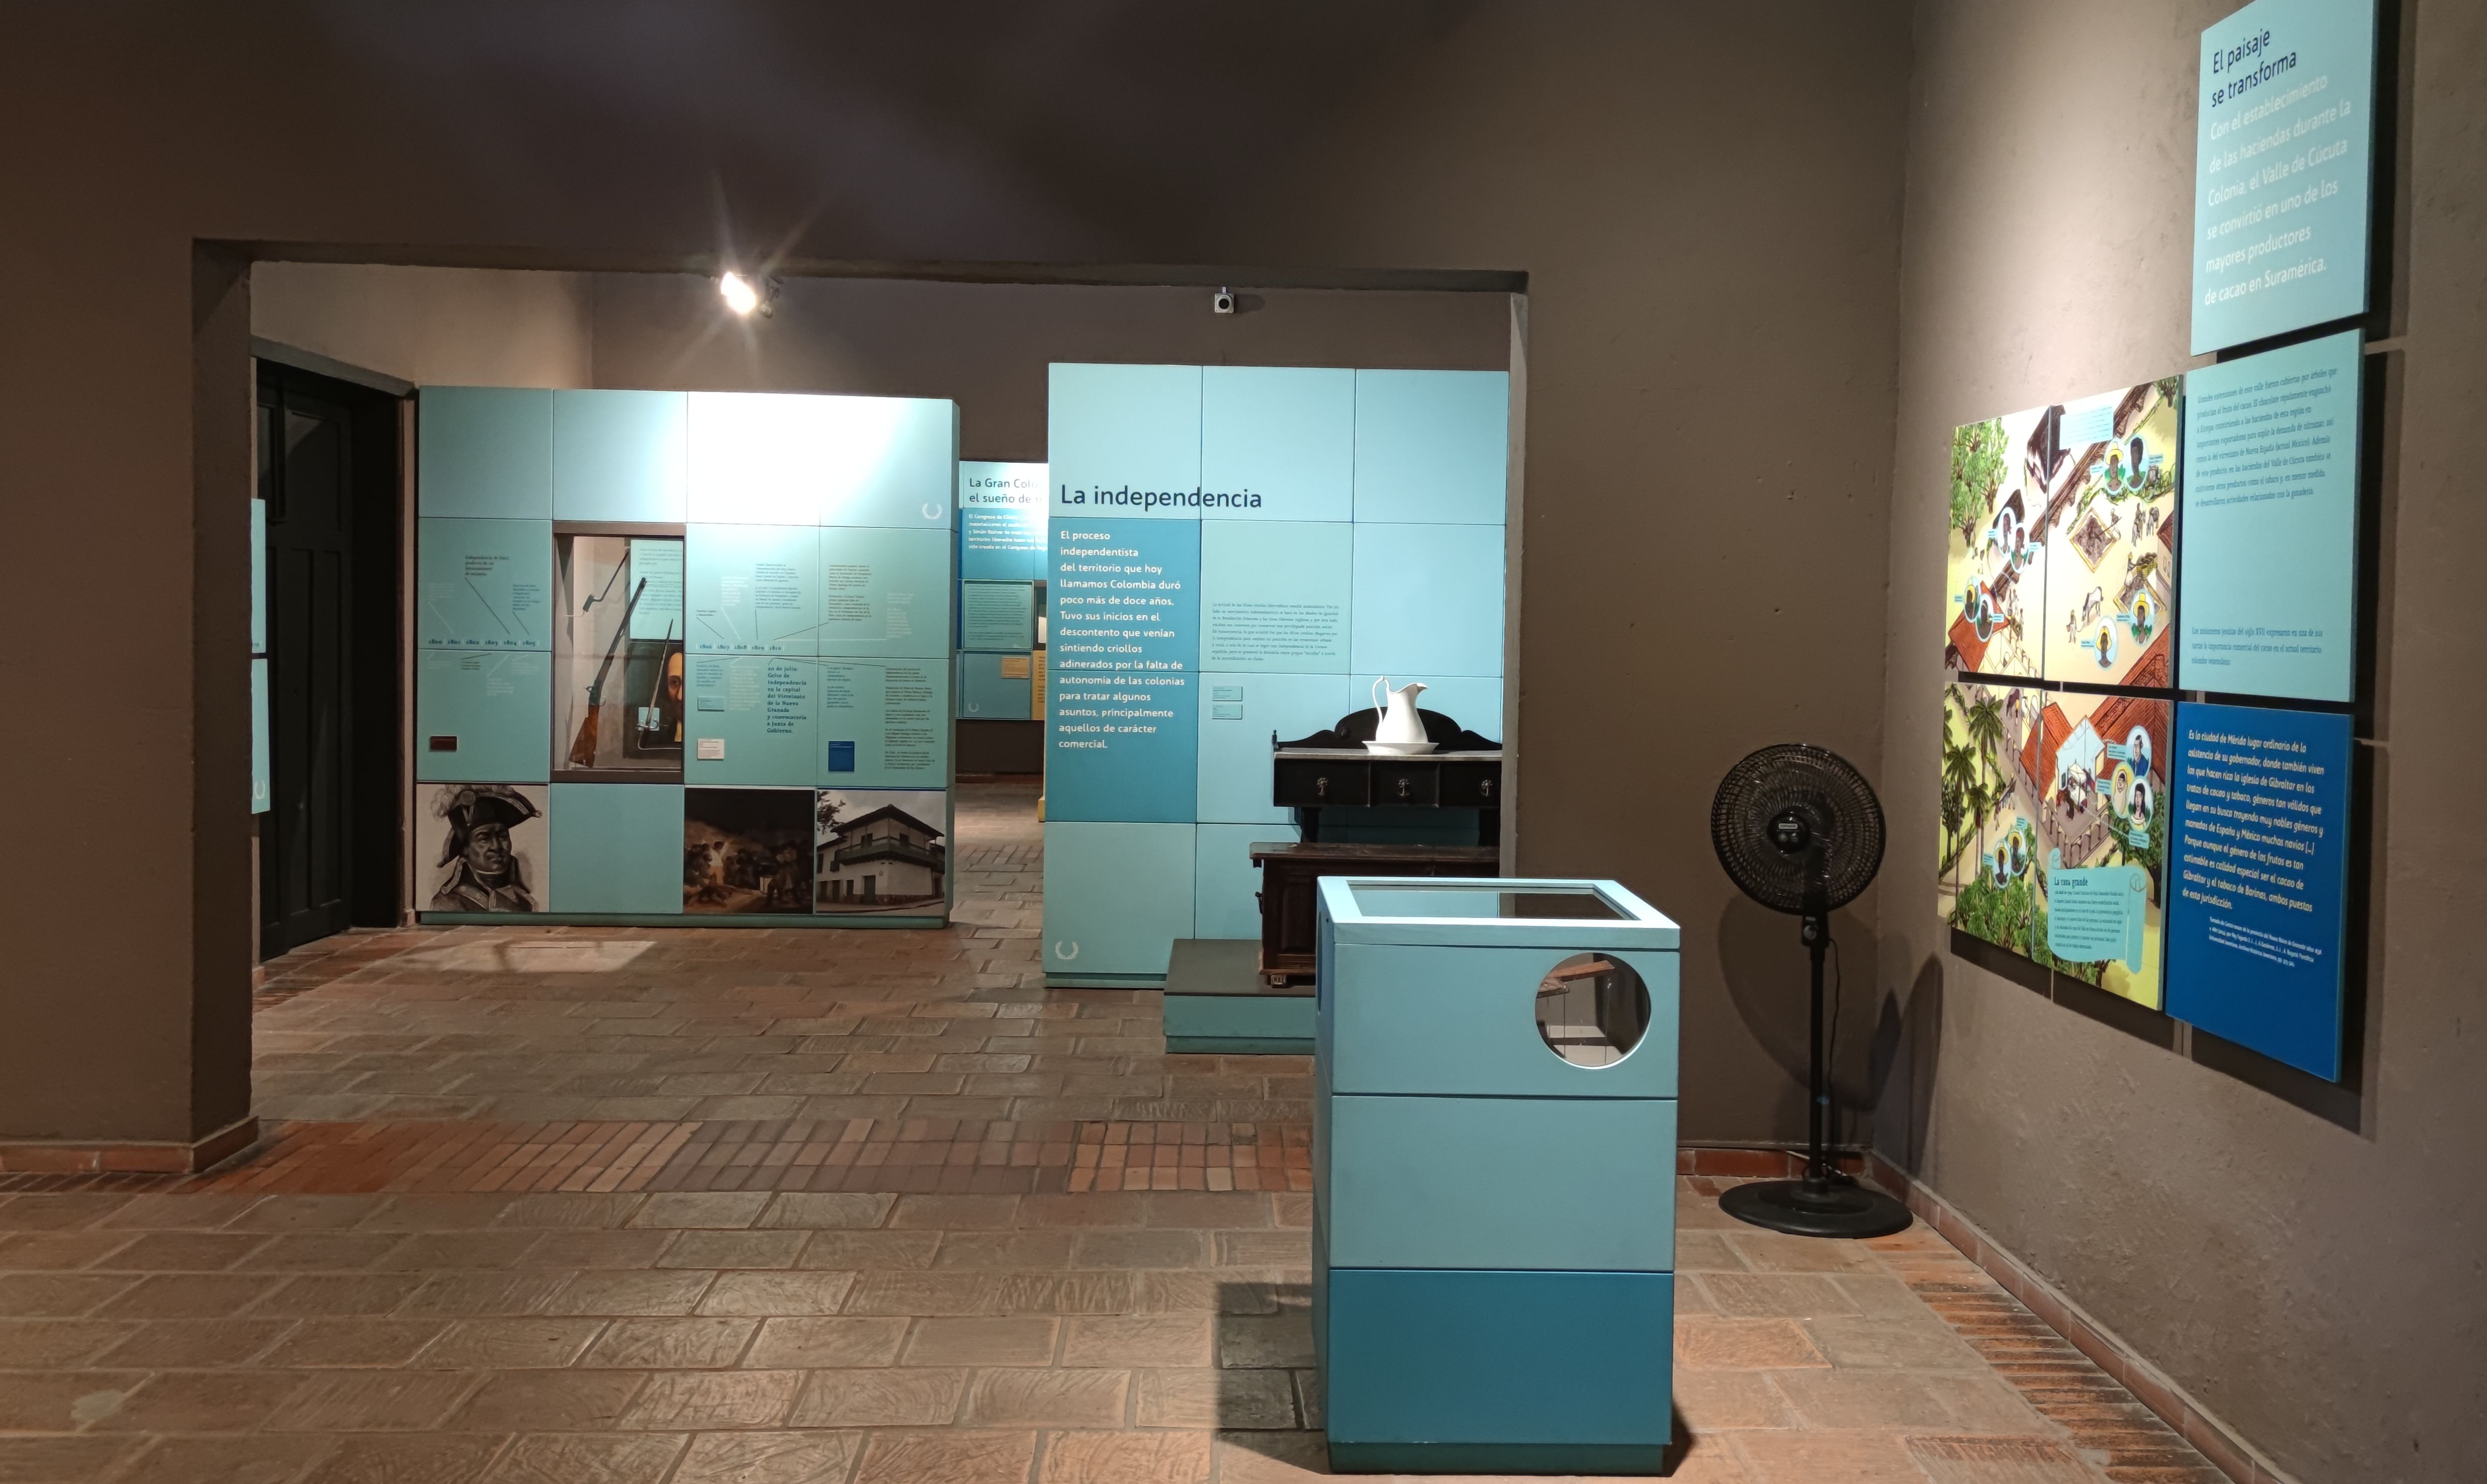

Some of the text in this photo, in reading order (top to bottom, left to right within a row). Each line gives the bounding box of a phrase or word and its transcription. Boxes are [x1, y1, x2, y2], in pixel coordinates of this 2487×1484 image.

[2213, 29, 2270, 74] El paisaje
[2211, 52, 2296, 108] se transforma
[2210, 75, 2327, 141] Con el establecimiento
[2209, 100, 2351, 174] de las haciendas durante la
[2208, 140, 2347, 207] Colonia, el Valle de Cúcuta
[2206, 179, 2338, 240] se convirtió en uno de los
[2206, 226, 2311, 273] mayores productores
[2204, 257, 2326, 306] de cacao en Suramérica.
[969, 478, 981, 487] La
[985, 478, 1010, 488] Gran
[969, 493, 979, 502] el
[983, 494, 1015, 503] sueño
[1019, 493, 1031, 503] de
[1062, 484, 1261, 512] La independencia
[1061, 530, 1110, 542] El proceso
[1061, 547, 1138, 558] independentista
[1060, 562, 1162, 575] del territorio que hoy
[1060, 578, 1181, 589] llamamos Colombia duró
[1060, 596, 1174, 606] poco más de doce años.
[1060, 611, 1083, 620] Tuvo
[1103, 612, 1133, 621] inicios
[1150, 613, 1160, 621] el
[1060, 627, 1175, 639] descontento que venían
[1060, 643, 1142, 653] sintiendo criollos
[1060, 659, 1183, 671] adinerados por la falta de
[1060, 676, 1185, 686] autonomía de las colonias
[1059, 693, 1081, 702] para
[1113, 692, 1151, 703] algunos
[1059, 708, 1174, 719] asuntos, principalmente
[1059, 723, 1157, 734] aquellos de carácter
[1059, 739, 1108, 748] comercial.
